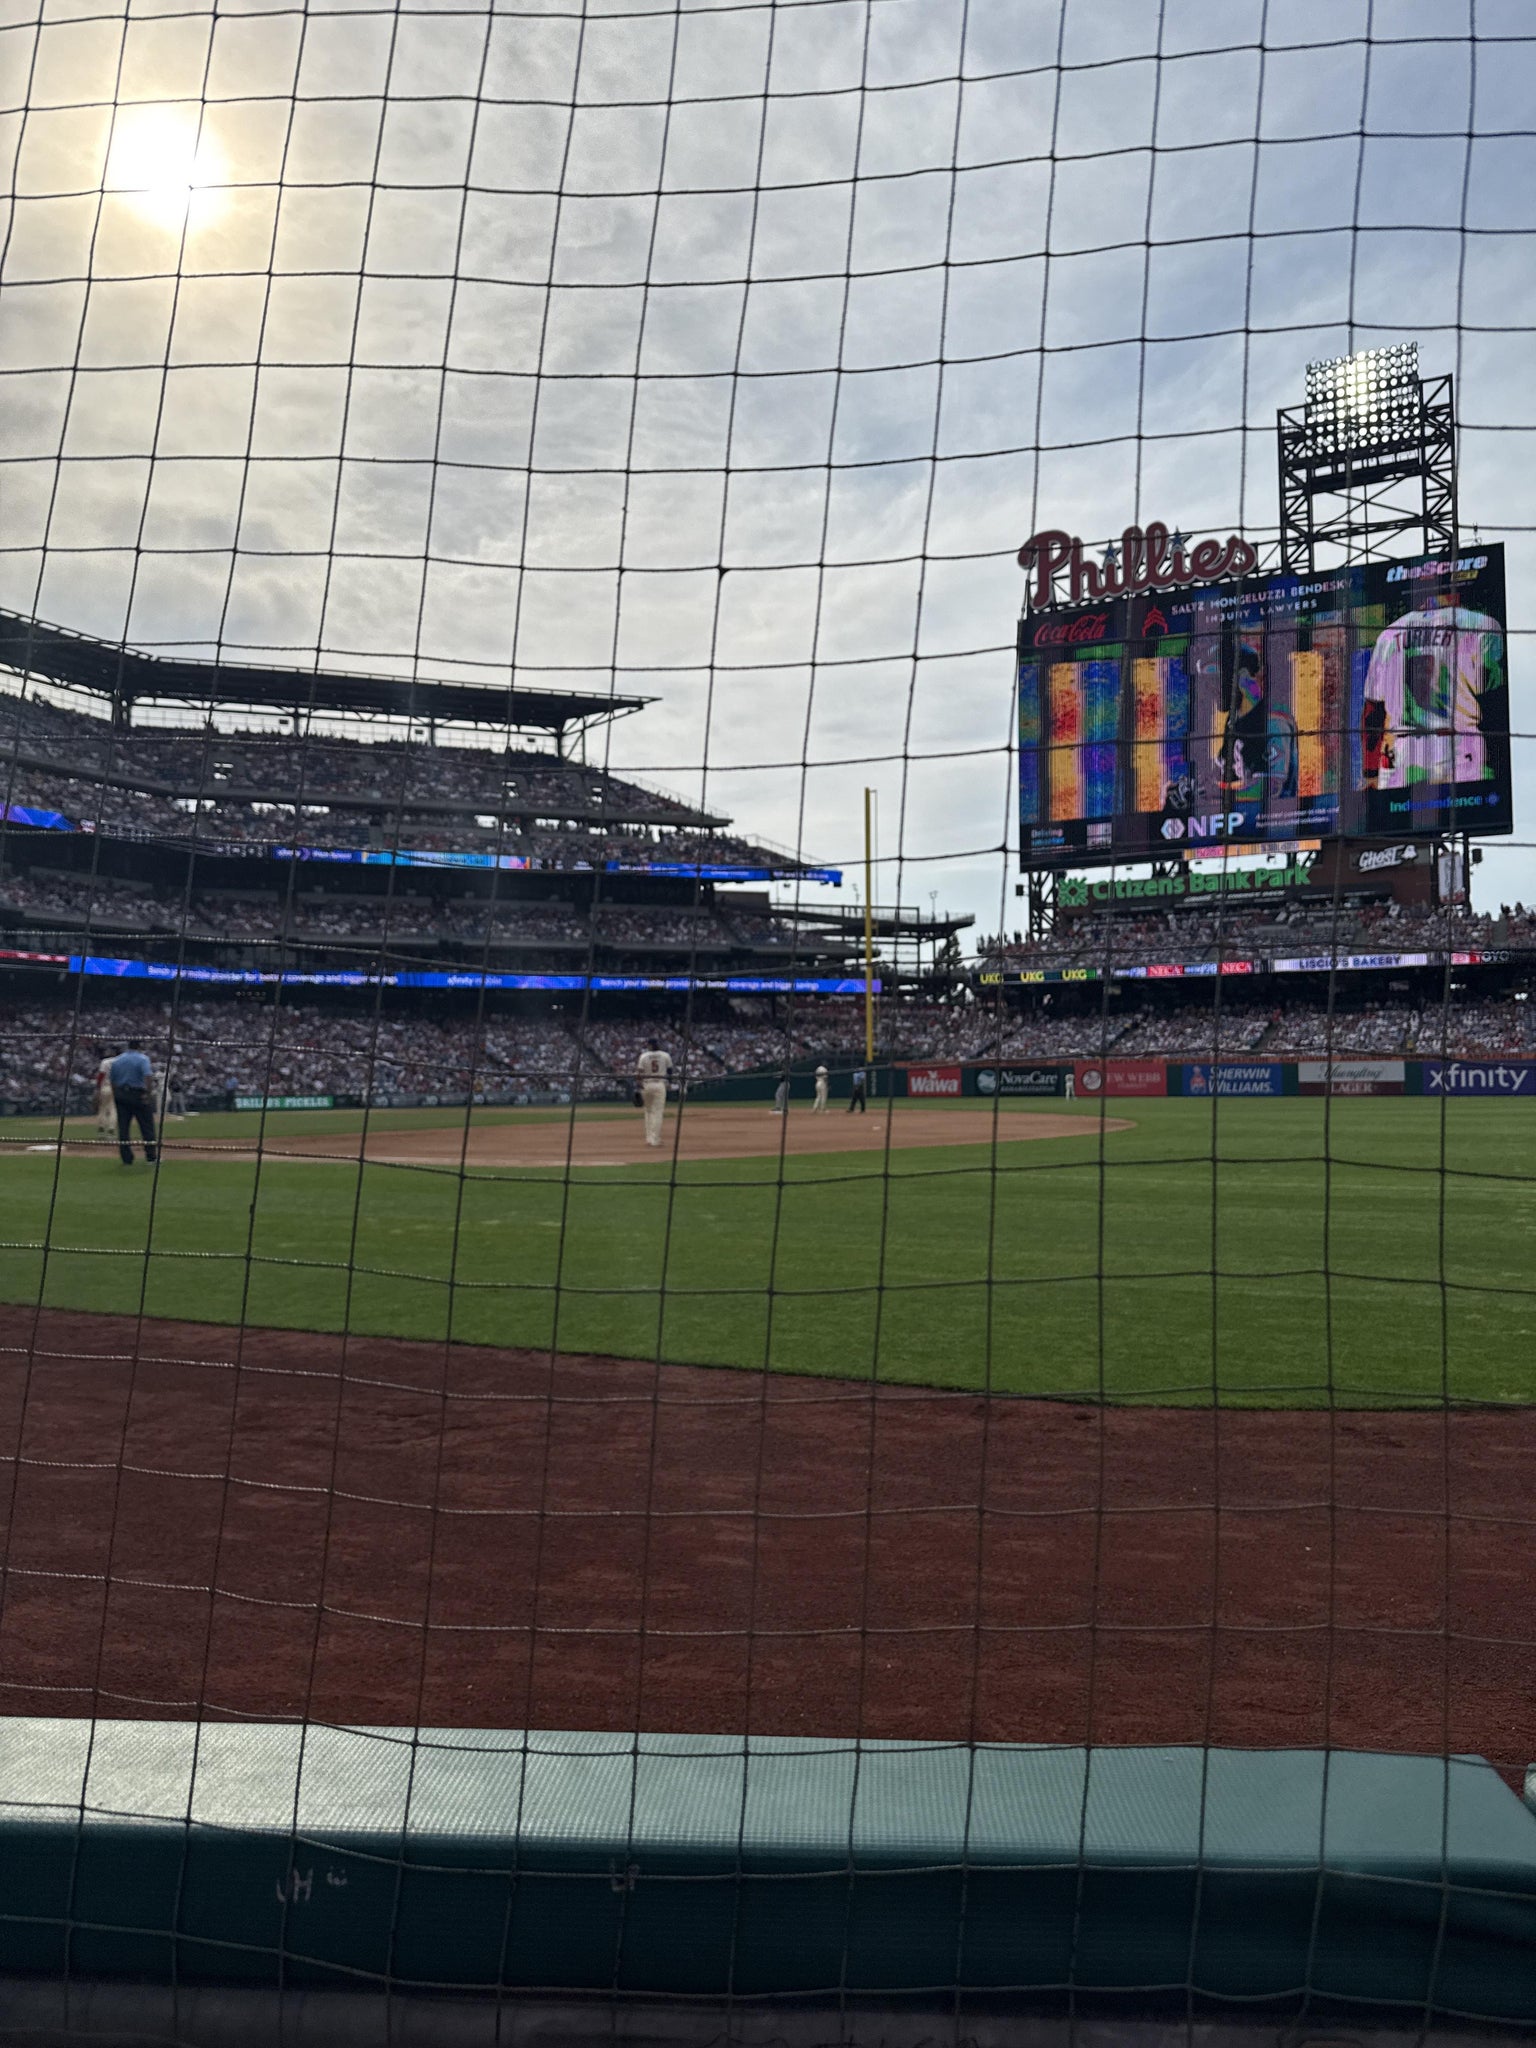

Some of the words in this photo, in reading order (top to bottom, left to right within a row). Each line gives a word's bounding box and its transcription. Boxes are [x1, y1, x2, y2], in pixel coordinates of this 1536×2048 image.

[1018, 521, 1257, 609] Phillies
[1386, 556, 1488, 582] theScore
[1171, 602, 1205, 616] SALTZ
[1291, 577, 1353, 597] BENDESKY
[1205, 609, 1250, 623] INJURY
[1260, 599, 1317, 615] LAWYERS
[1187, 811, 1245, 838] NFP
[1358, 845, 1407, 869] GHOST
[1092, 876, 1186, 900] Citizens
[1189, 868, 1251, 893] Bank
[1254, 863, 1311, 888] Park
[1300, 958, 1349, 970] LISCIO'S
[1353, 954, 1401, 967] BAKERY
[258, 973, 285, 981] bettr
[475, 975, 502, 985] mbile
[1020, 971, 1044, 983] UKG
[1062, 969, 1087, 981] UKG
[1000, 1071, 1058, 1085] NovaCare
[1127, 1072, 1161, 1083] WEBB
[1209, 1066, 1271, 1080] SHERWIN
[1429, 1063, 1528, 1091] xfinity
[910, 1075, 958, 1093] Wawa
[1330, 1082, 1373, 1093] LAGER
[285, 1096, 330, 1108] PICKLES
